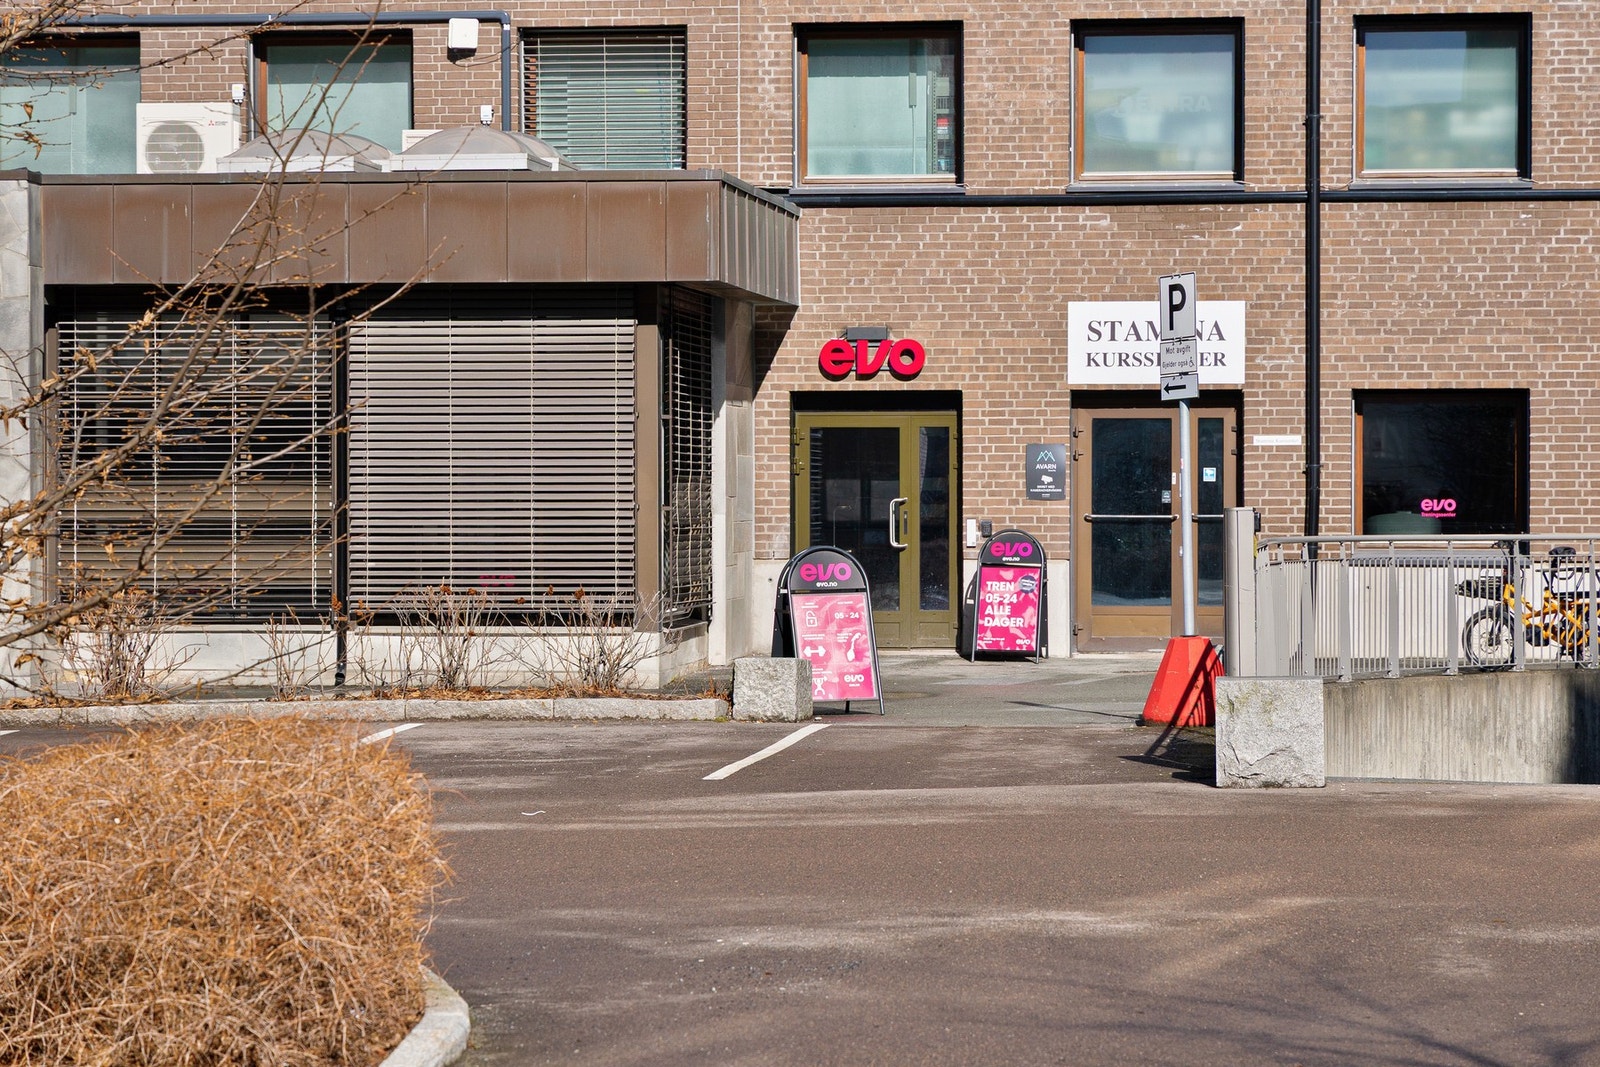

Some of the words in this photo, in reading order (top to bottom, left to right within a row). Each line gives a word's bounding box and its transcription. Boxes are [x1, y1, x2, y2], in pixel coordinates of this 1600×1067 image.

[1168, 283, 1187, 331] P
[1165, 346, 1175, 355] Mot
[1176, 344, 1191, 356] avgift
[818, 338, 926, 379] evo
[1420, 498, 1456, 511] evo
[990, 541, 1033, 557] evo
[799, 562, 852, 582] evo
[986, 581, 1015, 592] TREN
[985, 593, 1018, 604] 05-24
[984, 605, 1012, 615] ALLE
[983, 617, 1025, 628] DAGER
[844, 674, 865, 682] evo
